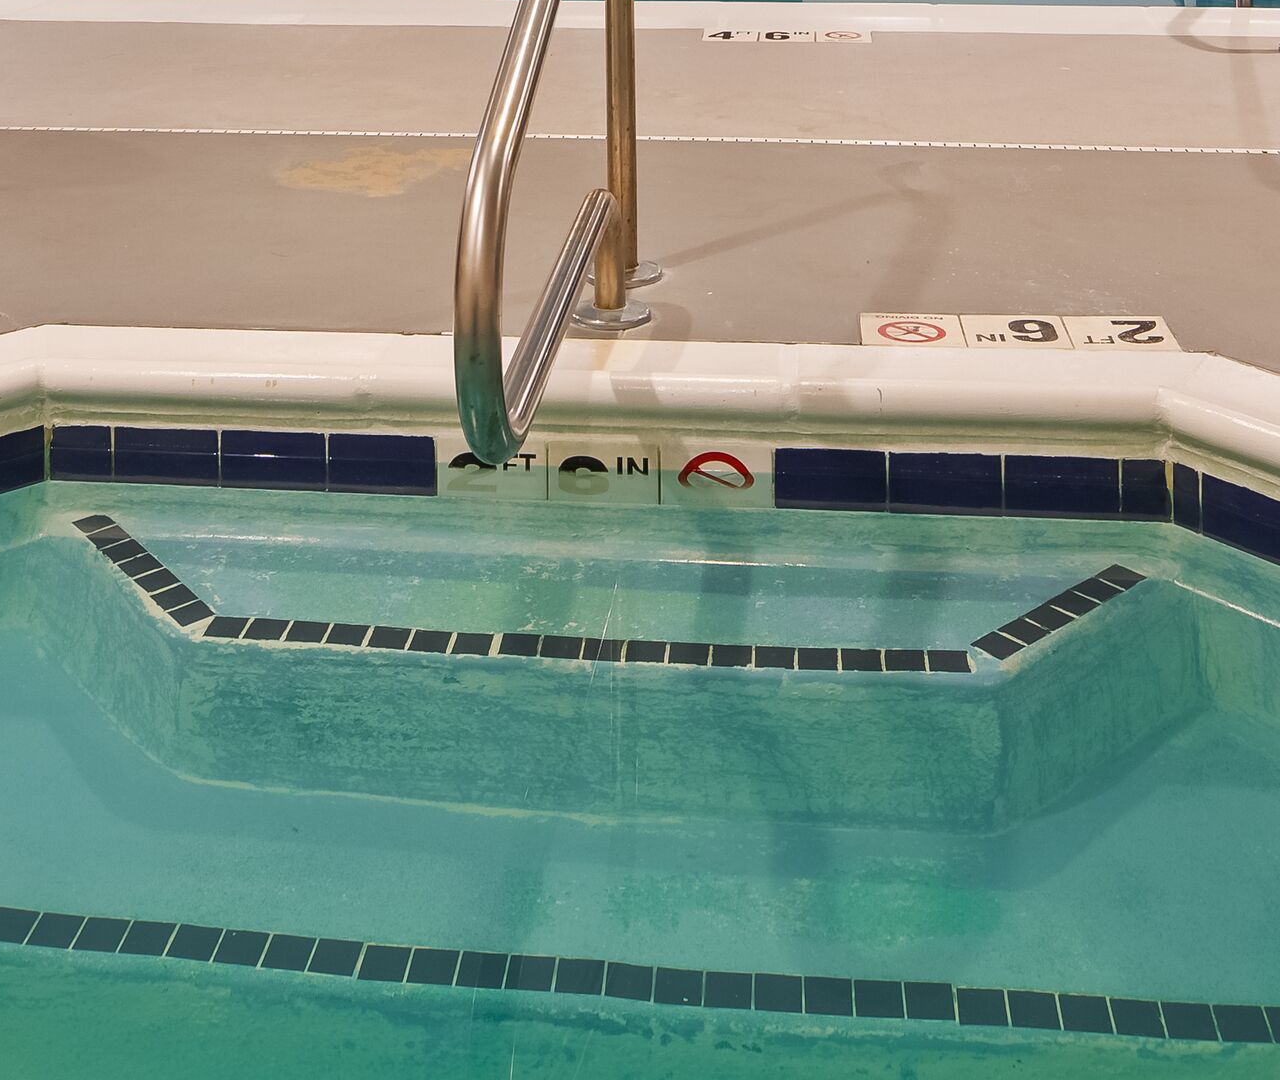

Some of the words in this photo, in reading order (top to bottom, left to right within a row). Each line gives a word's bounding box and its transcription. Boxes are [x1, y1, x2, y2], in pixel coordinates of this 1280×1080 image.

[708, 31, 734, 40] 4
[765, 31, 790, 41] 6
[976, 333, 1005, 343] IN
[1007, 319, 1059, 343] 6
[1111, 320, 1164, 344] 2
[1083, 335, 1115, 345] FT
[616, 457, 649, 475] IN
